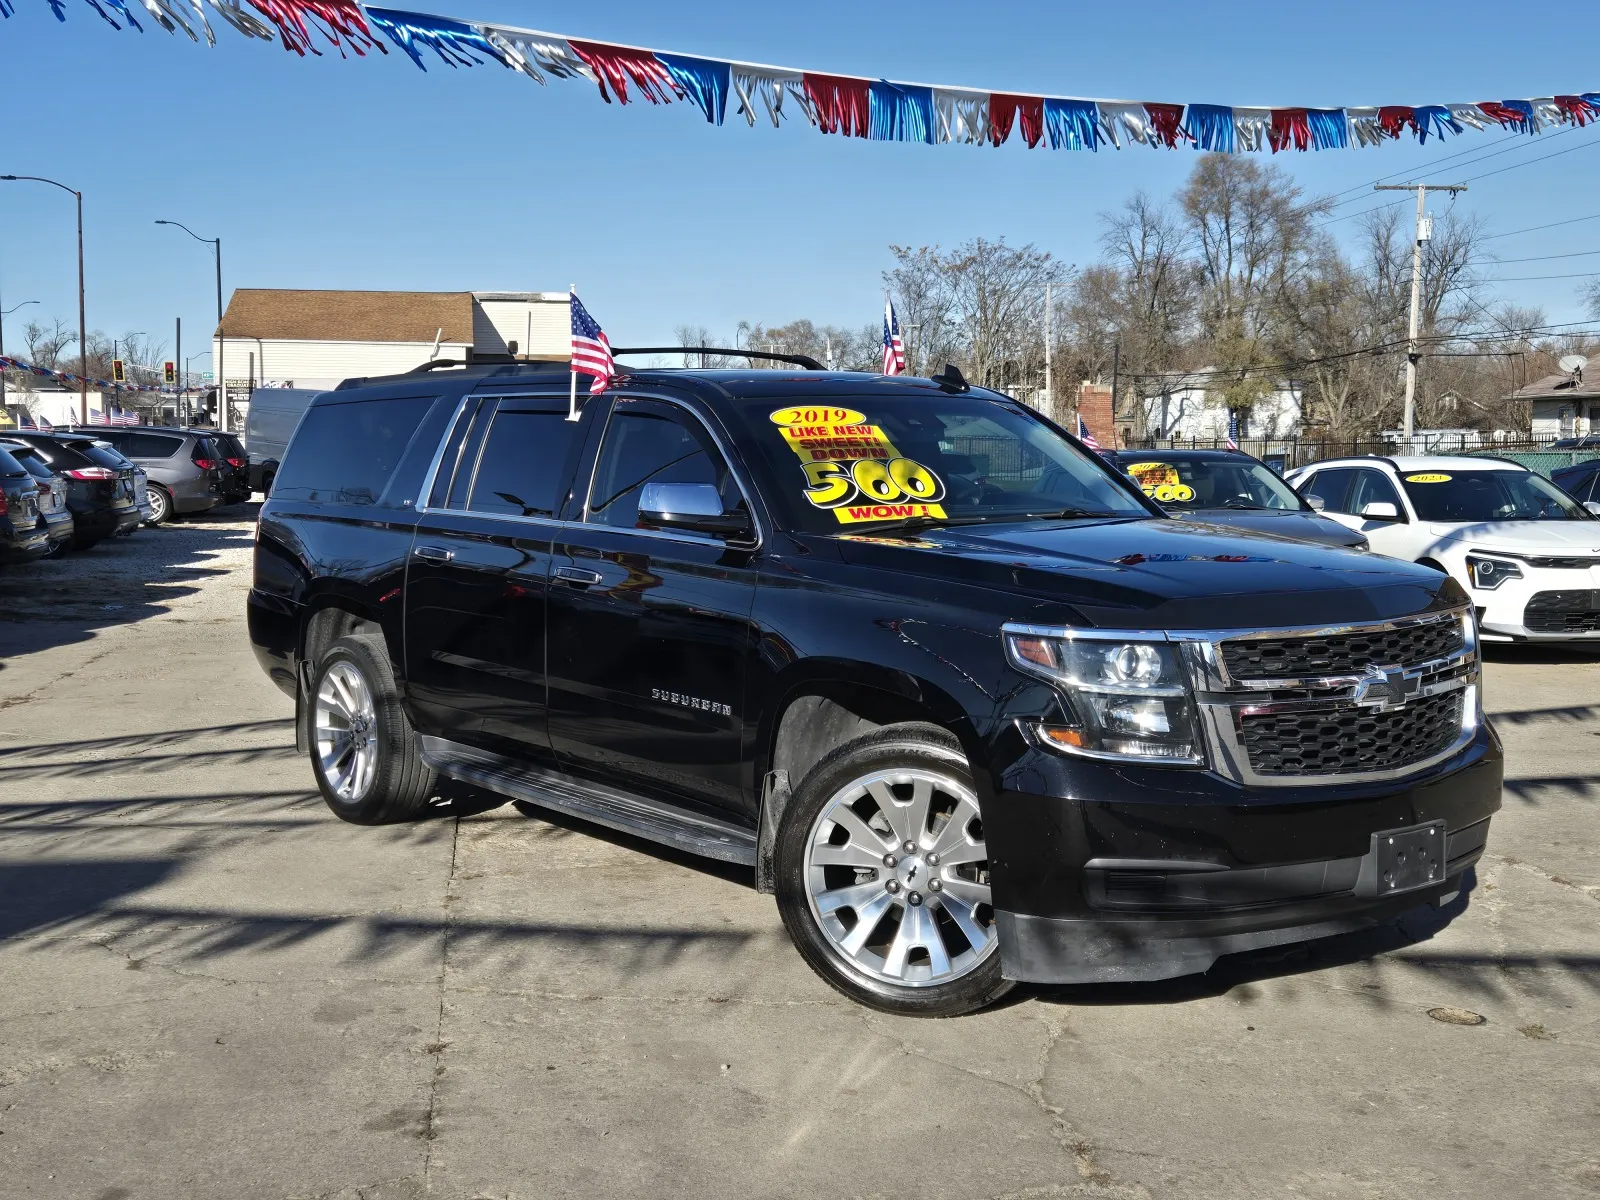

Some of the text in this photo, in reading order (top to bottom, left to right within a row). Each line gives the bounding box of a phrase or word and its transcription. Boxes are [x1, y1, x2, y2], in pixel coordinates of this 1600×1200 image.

[790, 409, 847, 424] 2019
[789, 425, 873, 438] LIKE NEW
[799, 436, 882, 449] SWEET!
[810, 447, 890, 460] DOWN
[800, 457, 946, 509] 500
[848, 505, 915, 520] WOW
[651, 688, 732, 716] SUBURBAN
